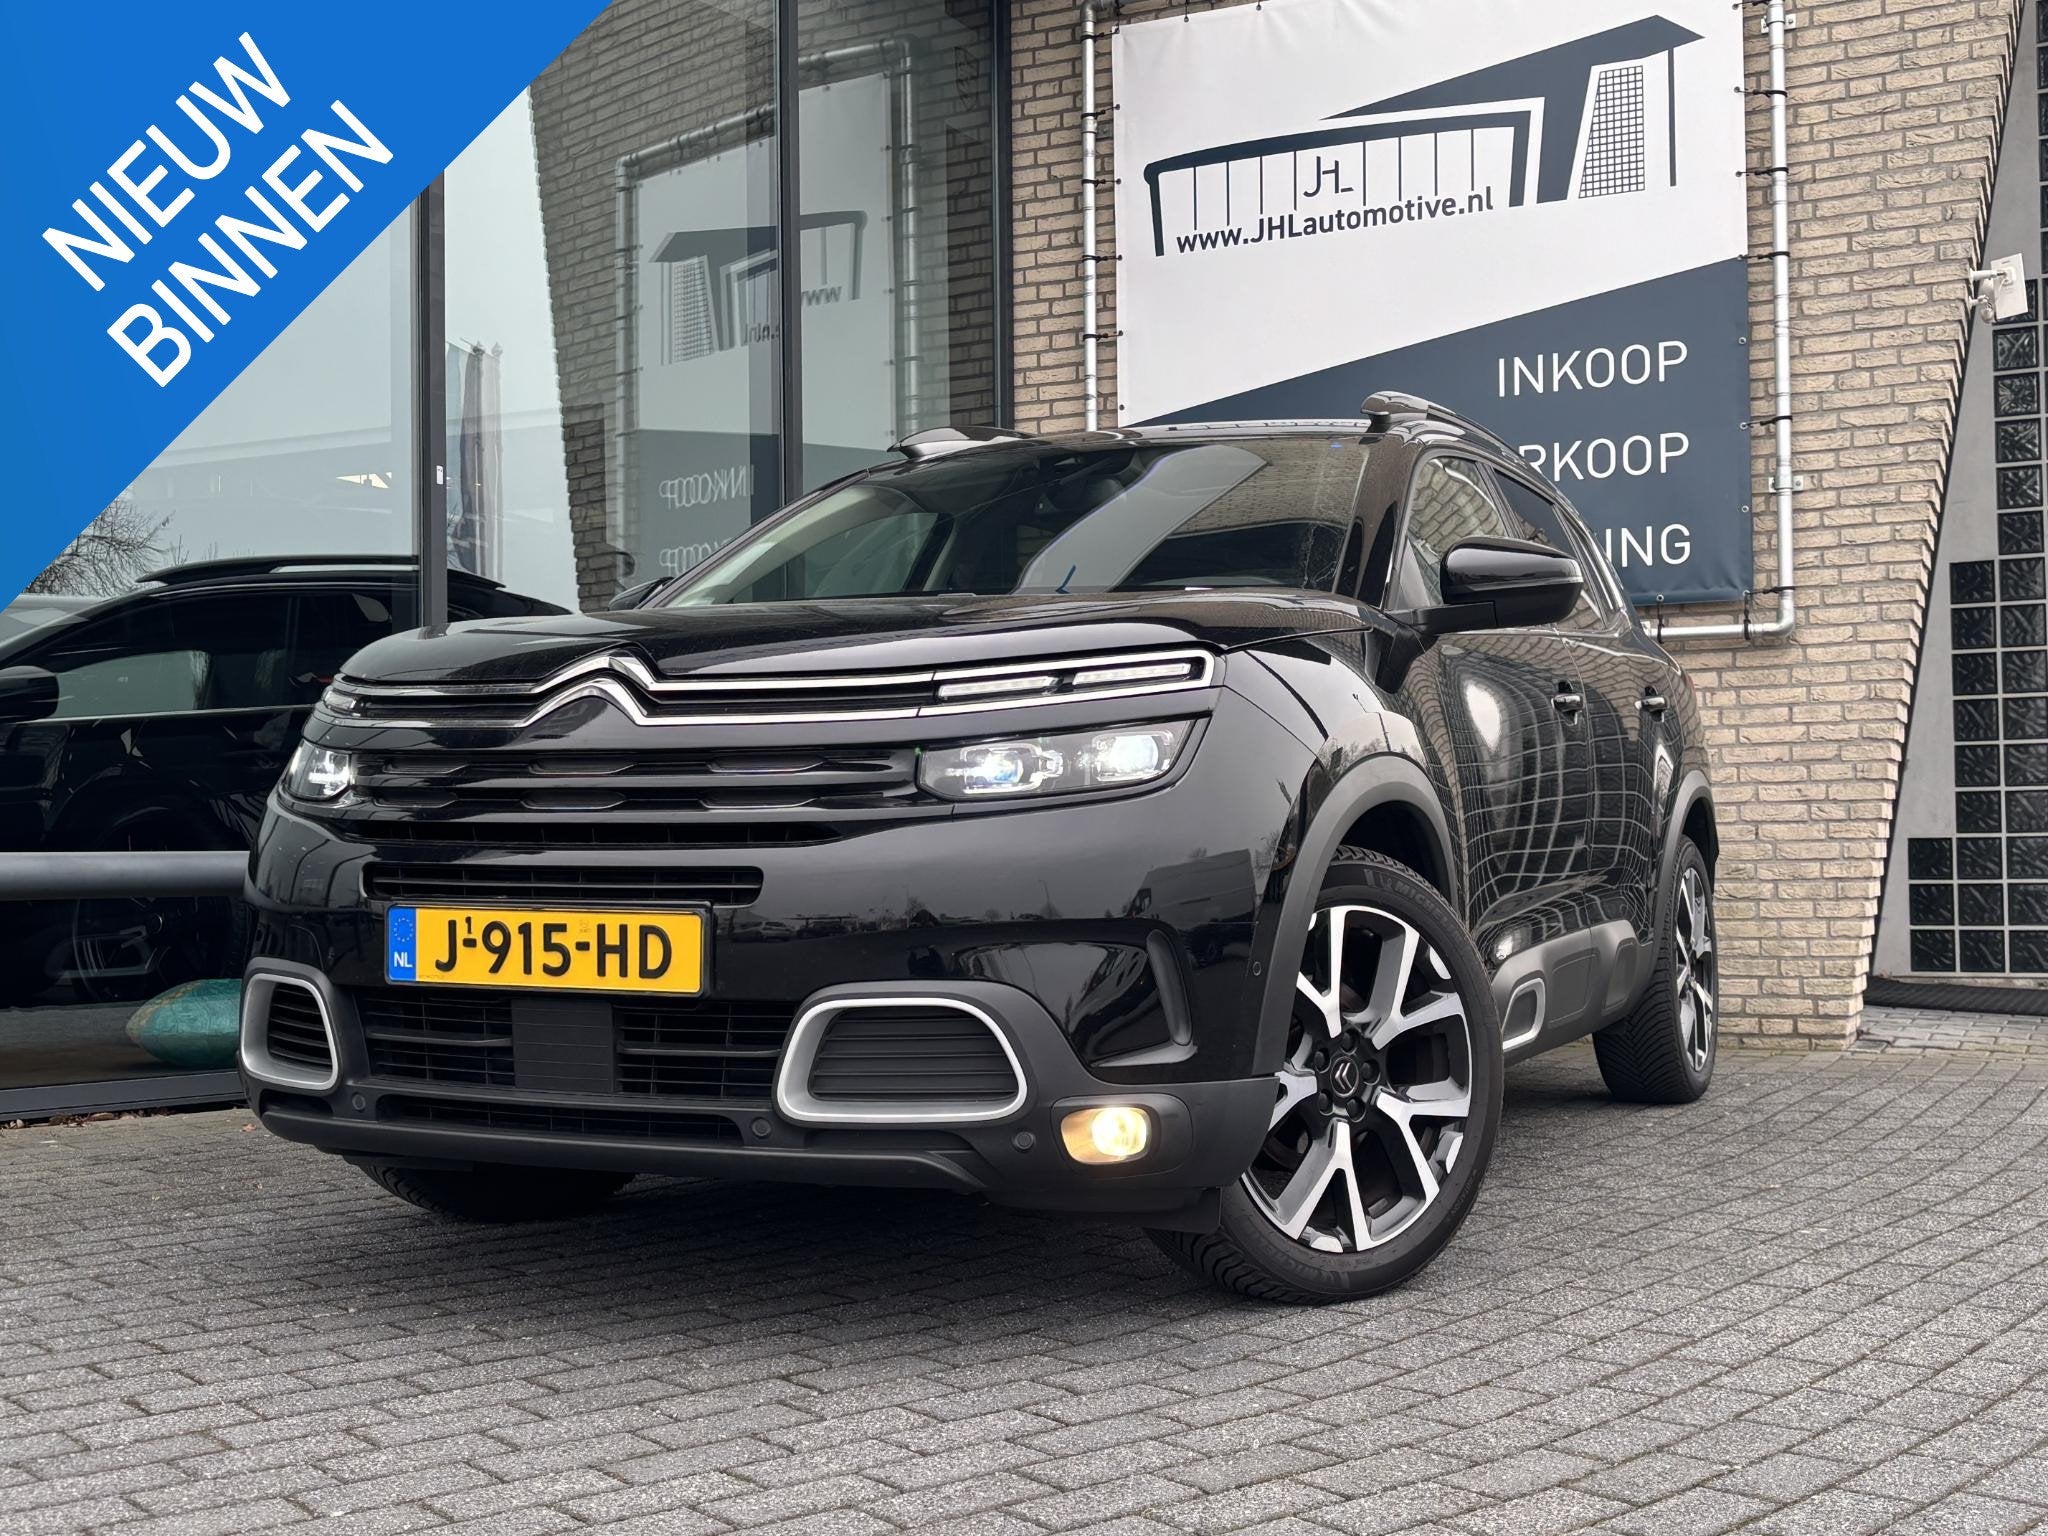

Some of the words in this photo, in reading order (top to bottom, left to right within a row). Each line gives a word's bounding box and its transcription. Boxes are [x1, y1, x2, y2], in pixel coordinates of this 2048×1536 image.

[1176, 186, 1494, 254] www.JHLautomotive.nl
[1498, 340, 1688, 398] INKOOP
[1596, 523, 1692, 568] ING
[393, 952, 413, 968] NL
